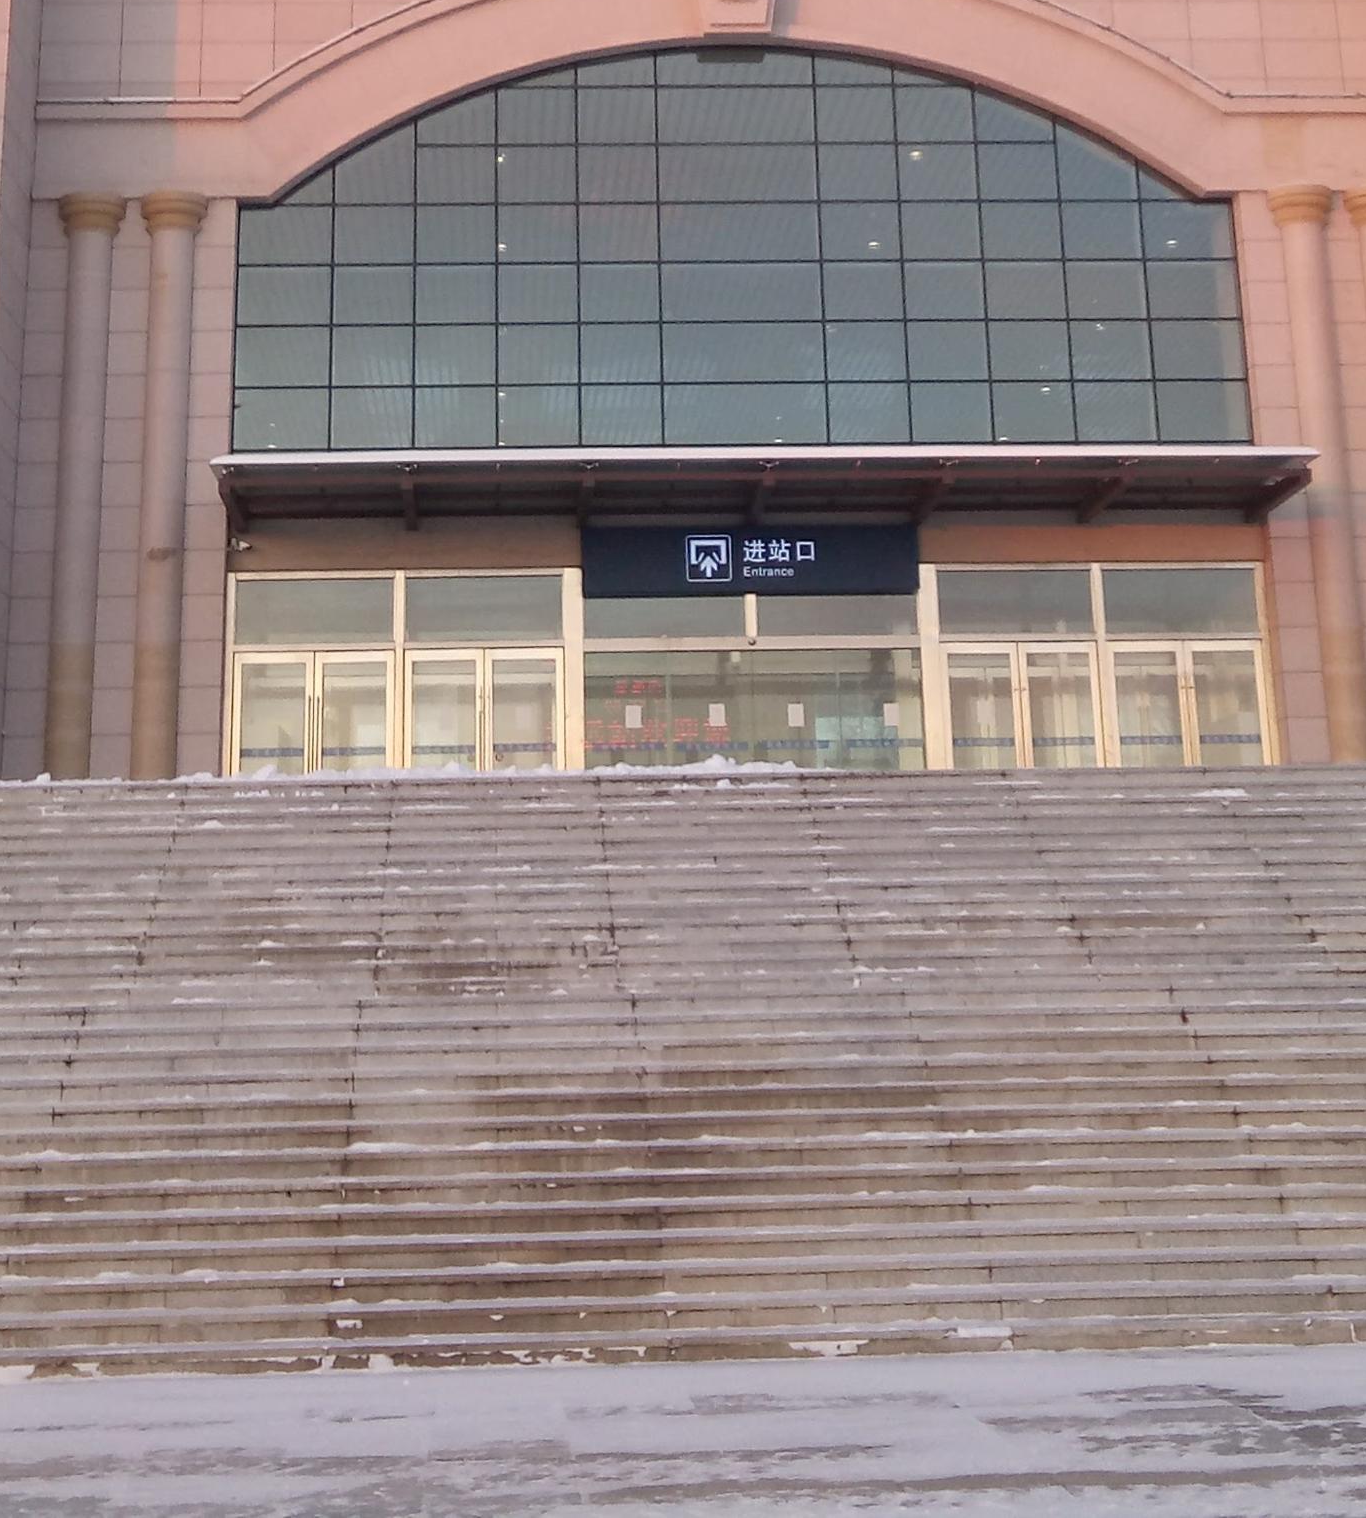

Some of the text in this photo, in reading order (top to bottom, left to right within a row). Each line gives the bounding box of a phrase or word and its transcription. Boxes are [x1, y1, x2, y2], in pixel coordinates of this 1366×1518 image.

[743, 539, 815, 562] 进站口
[743, 566, 794, 577] Entrance
